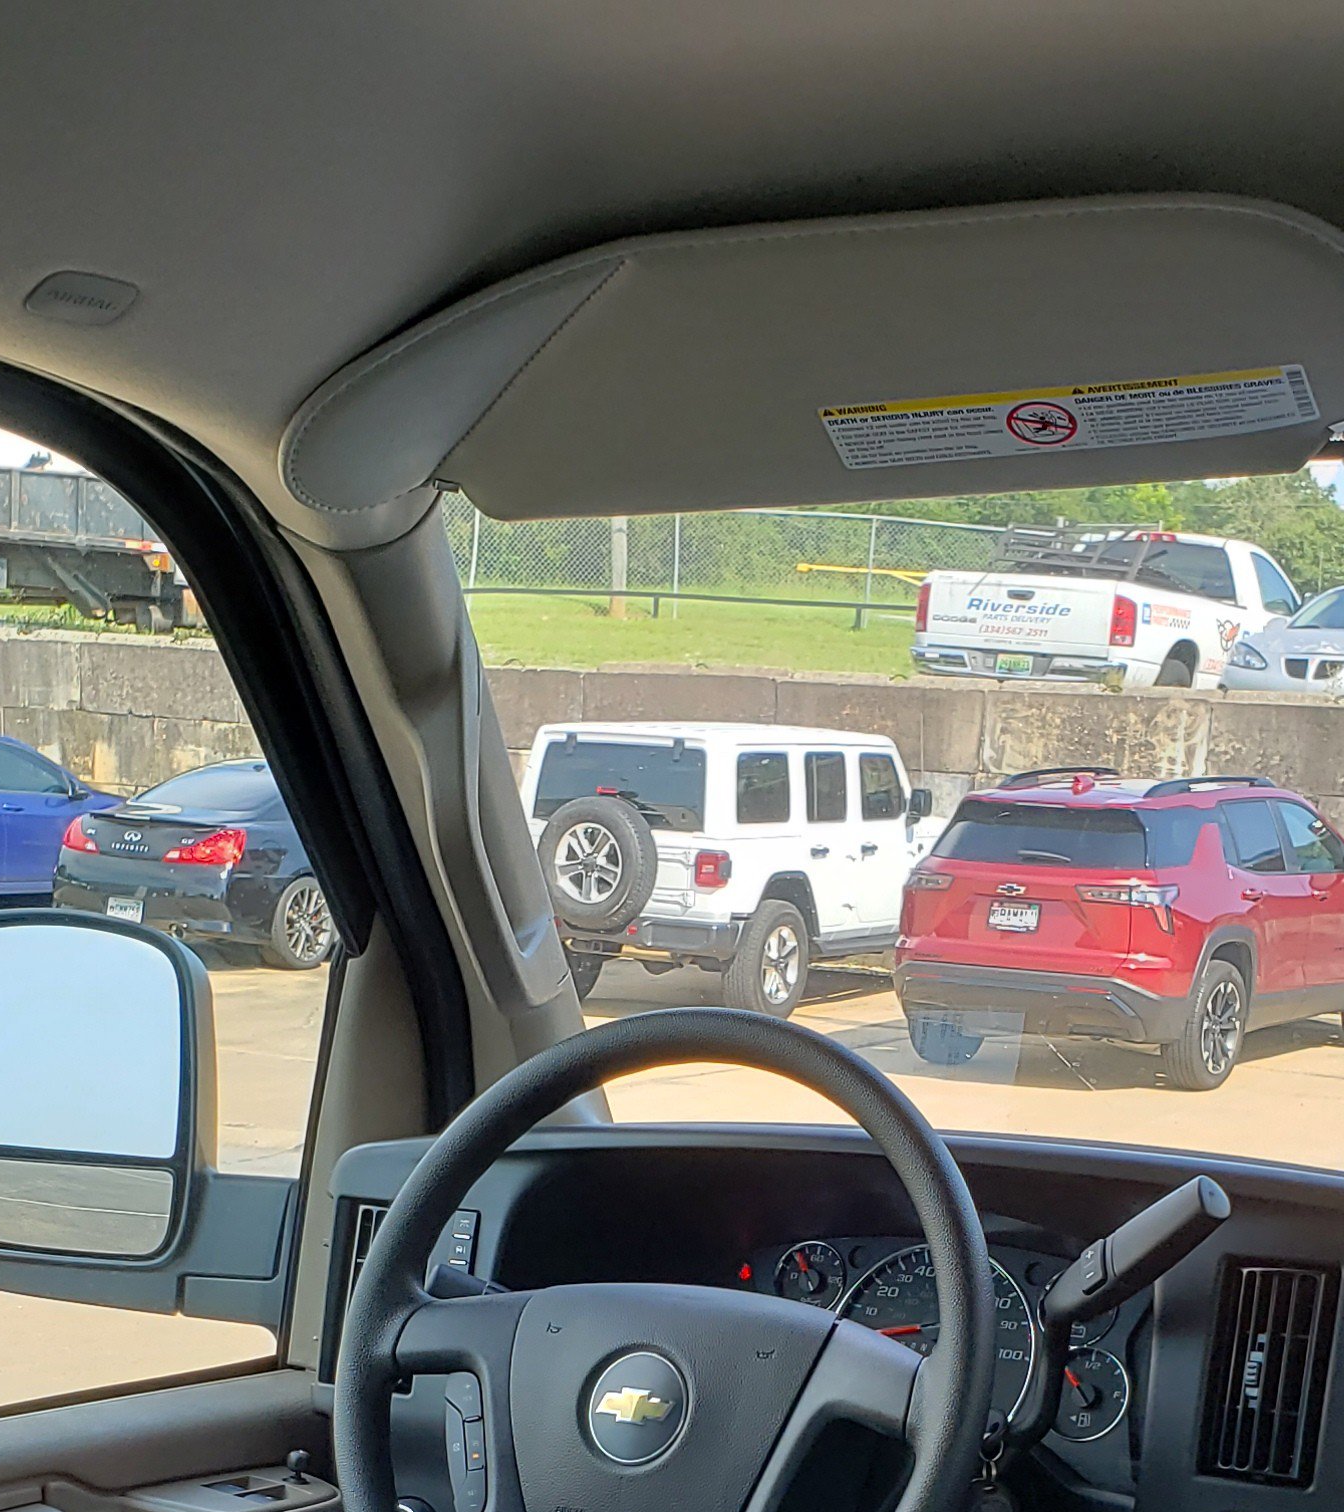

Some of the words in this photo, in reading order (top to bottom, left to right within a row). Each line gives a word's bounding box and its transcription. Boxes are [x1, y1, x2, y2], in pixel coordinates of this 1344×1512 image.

[1088, 379, 1178, 394] AVERTISSEMENT
[836, 404, 887, 415] WARNING
[828, 418, 858, 426] DEATH
[871, 413, 910, 423] SERIOUS
[912, 410, 944, 419] INJURY
[966, 598, 1072, 616] Riverside
[932, 614, 978, 624] DODGE
[983, 613, 1008, 622] PARTS
[1011, 614, 1052, 624] DELIVERY
[914, 1266, 936, 1277] 40
[896, 1274, 913, 1283] 30
[876, 1286, 900, 1298] 20
[865, 1306, 878, 1316] 10
[1000, 1321, 1018, 1331] 90
[998, 1349, 1024, 1361] 100
